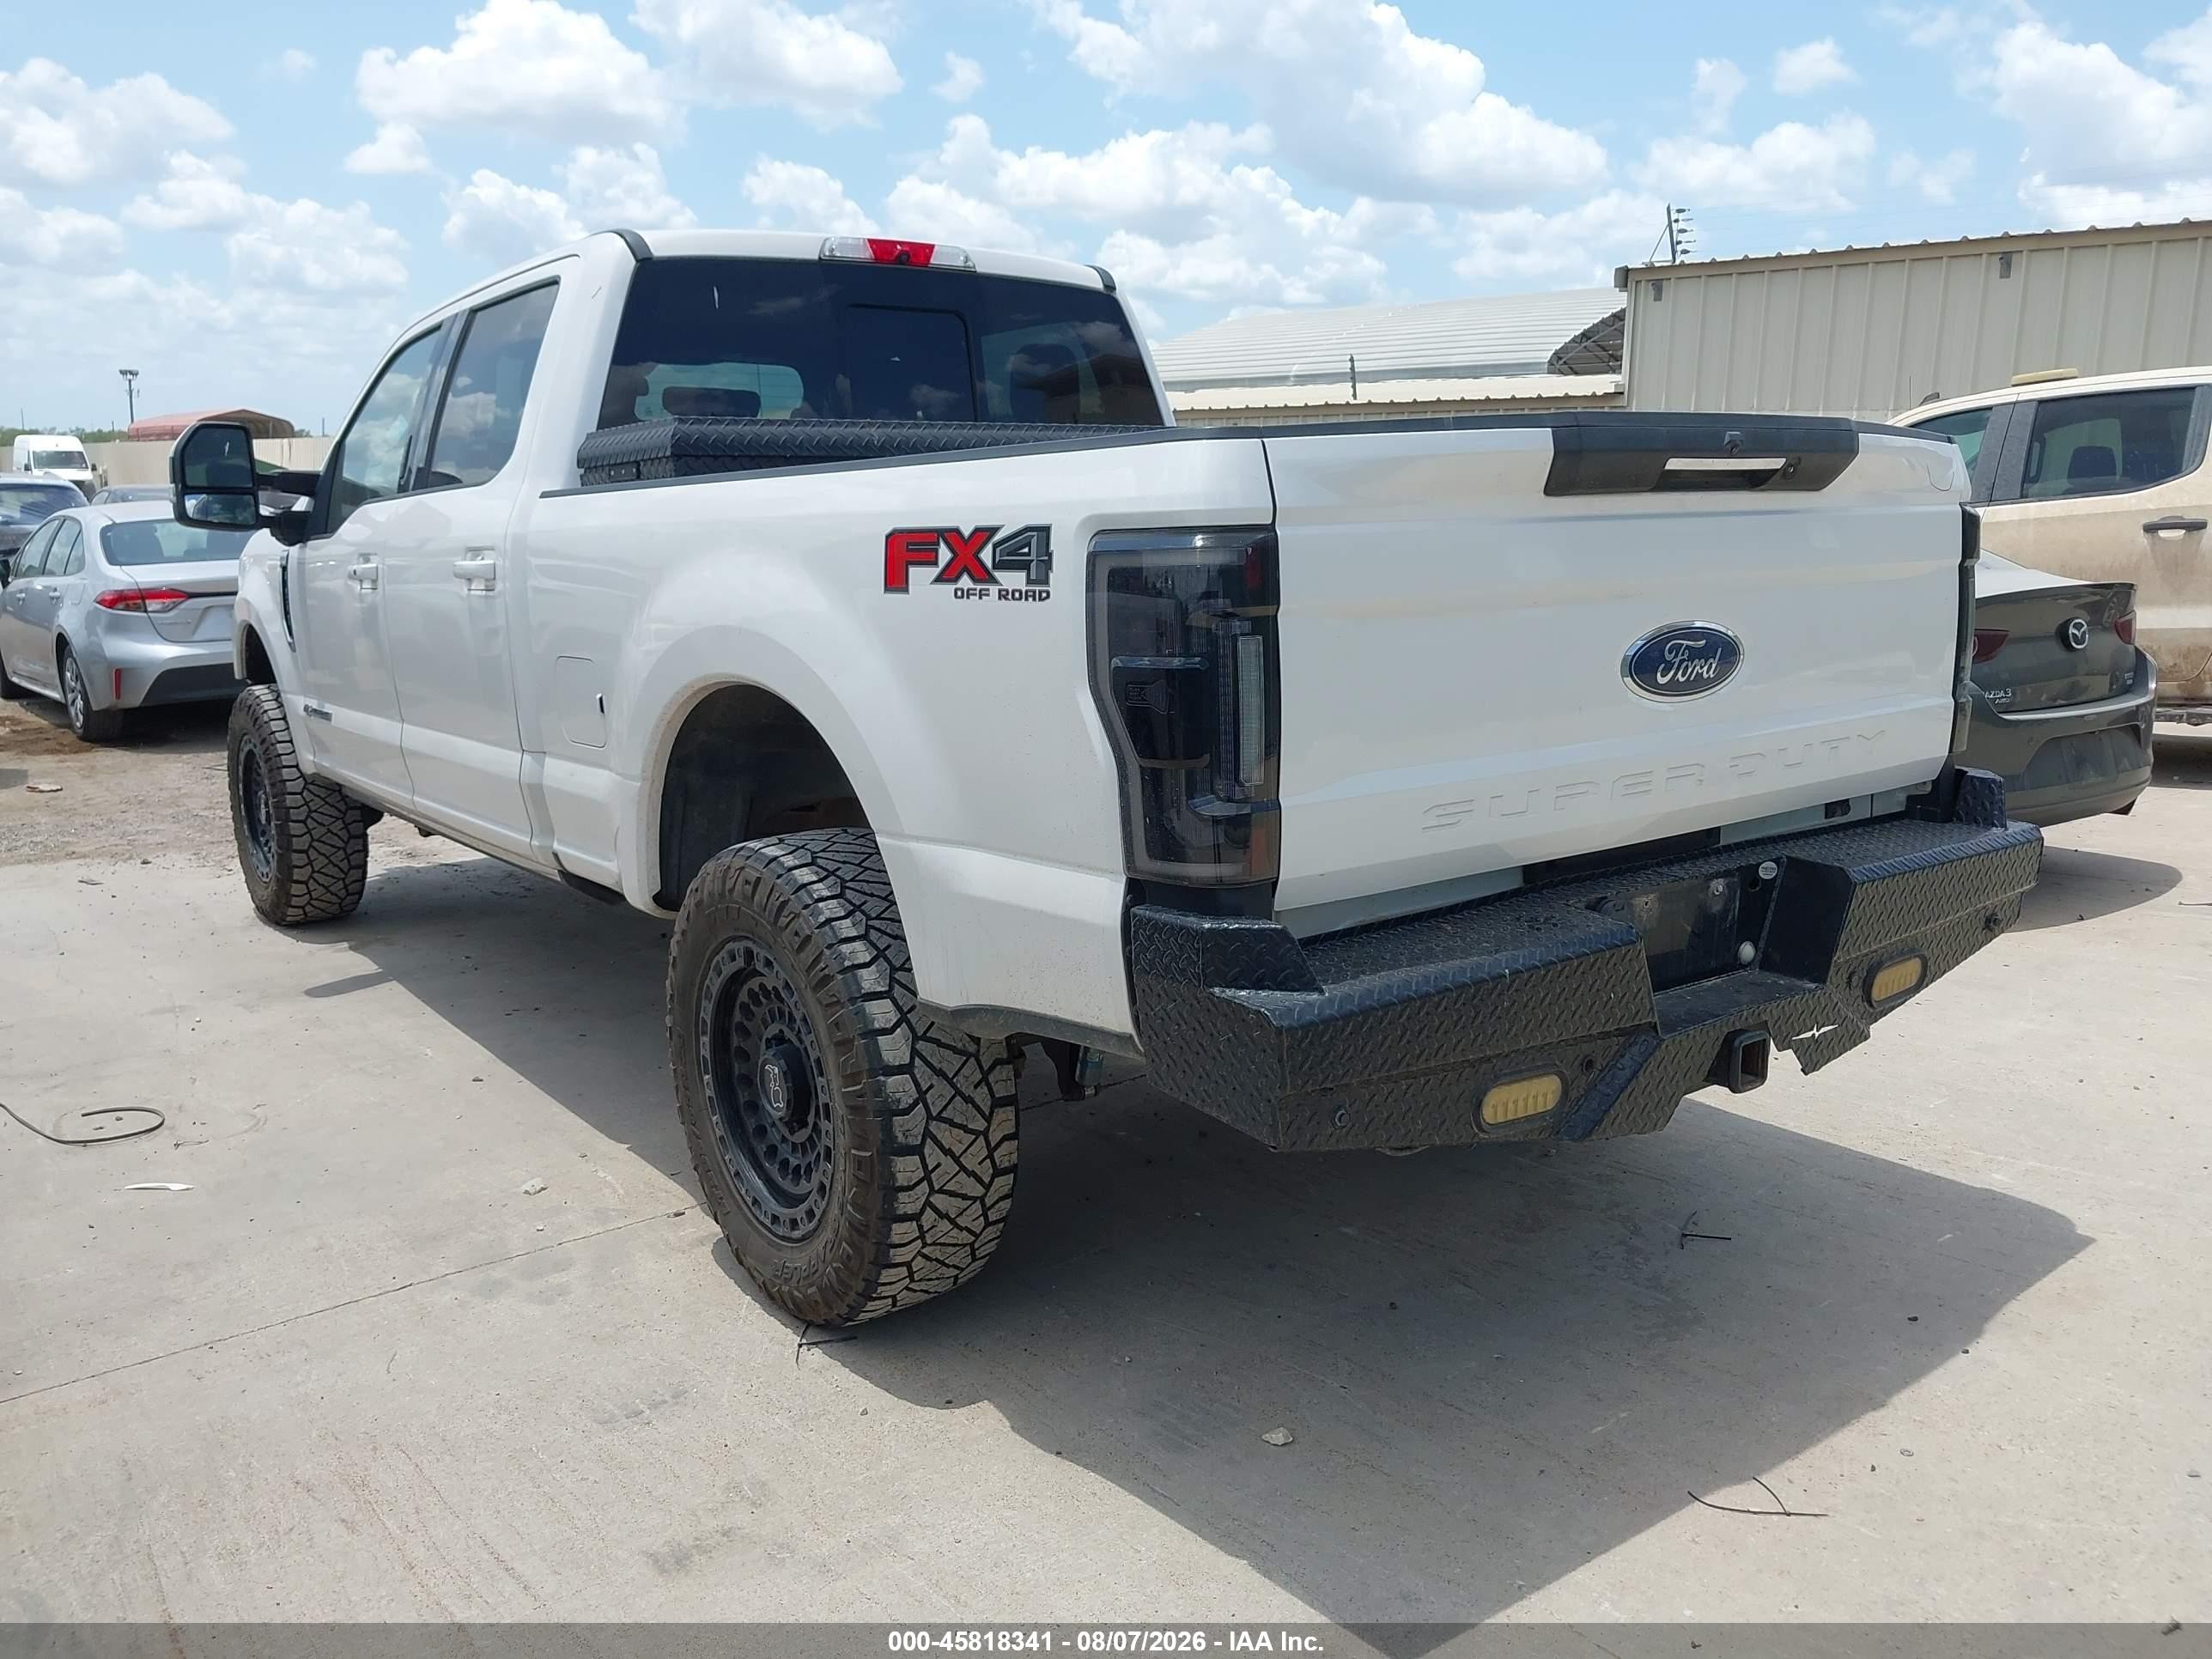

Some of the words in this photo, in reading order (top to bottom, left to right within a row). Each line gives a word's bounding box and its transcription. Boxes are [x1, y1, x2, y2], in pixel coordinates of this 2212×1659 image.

[884, 524, 1054, 594] FX4
[953, 586, 991, 600] OFF
[997, 588, 1051, 602] ROAD
[1656, 639, 1723, 685] Ford
[1984, 688, 2012, 698] AZDA3
[1421, 762, 1707, 833] SUPER
[1729, 729, 1887, 776] DUTY
